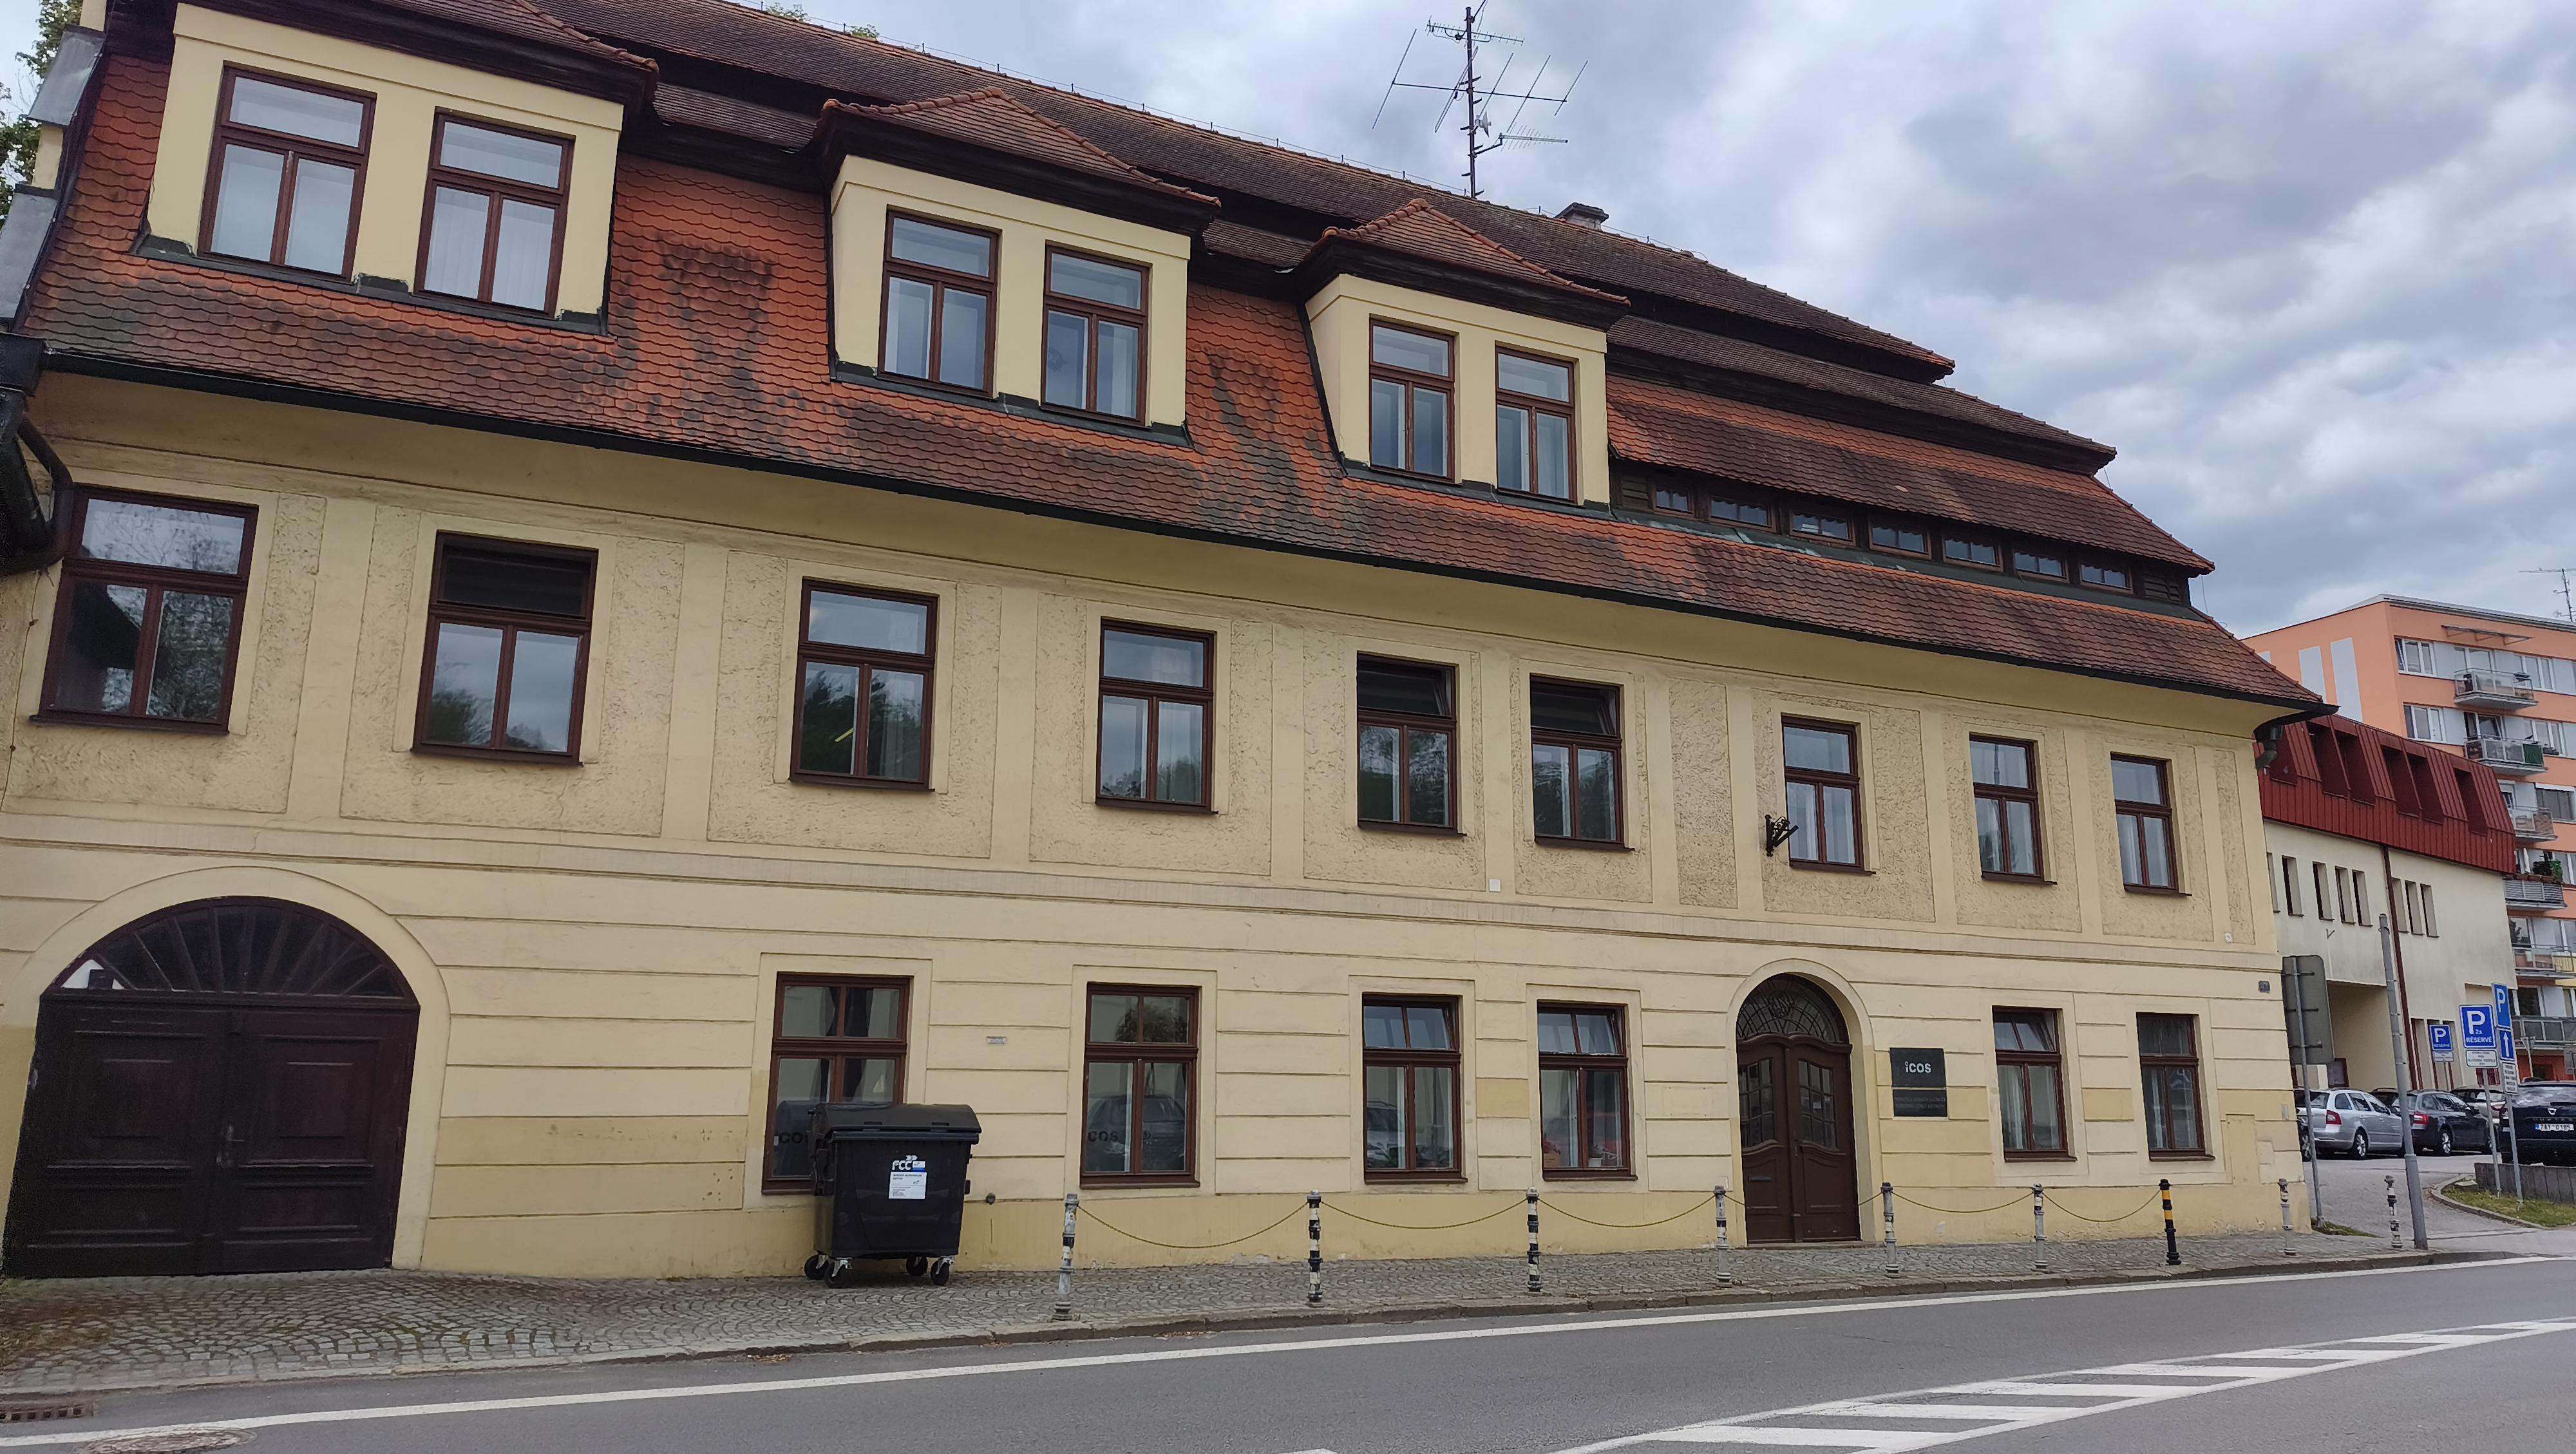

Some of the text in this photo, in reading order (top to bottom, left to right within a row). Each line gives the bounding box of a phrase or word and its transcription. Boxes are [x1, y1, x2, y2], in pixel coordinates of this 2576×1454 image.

[2496, 988, 2506, 1013] P
[2467, 1010, 2486, 1035] P
[2434, 1028, 2447, 1043] P
[892, 1160, 913, 1171] FCC
